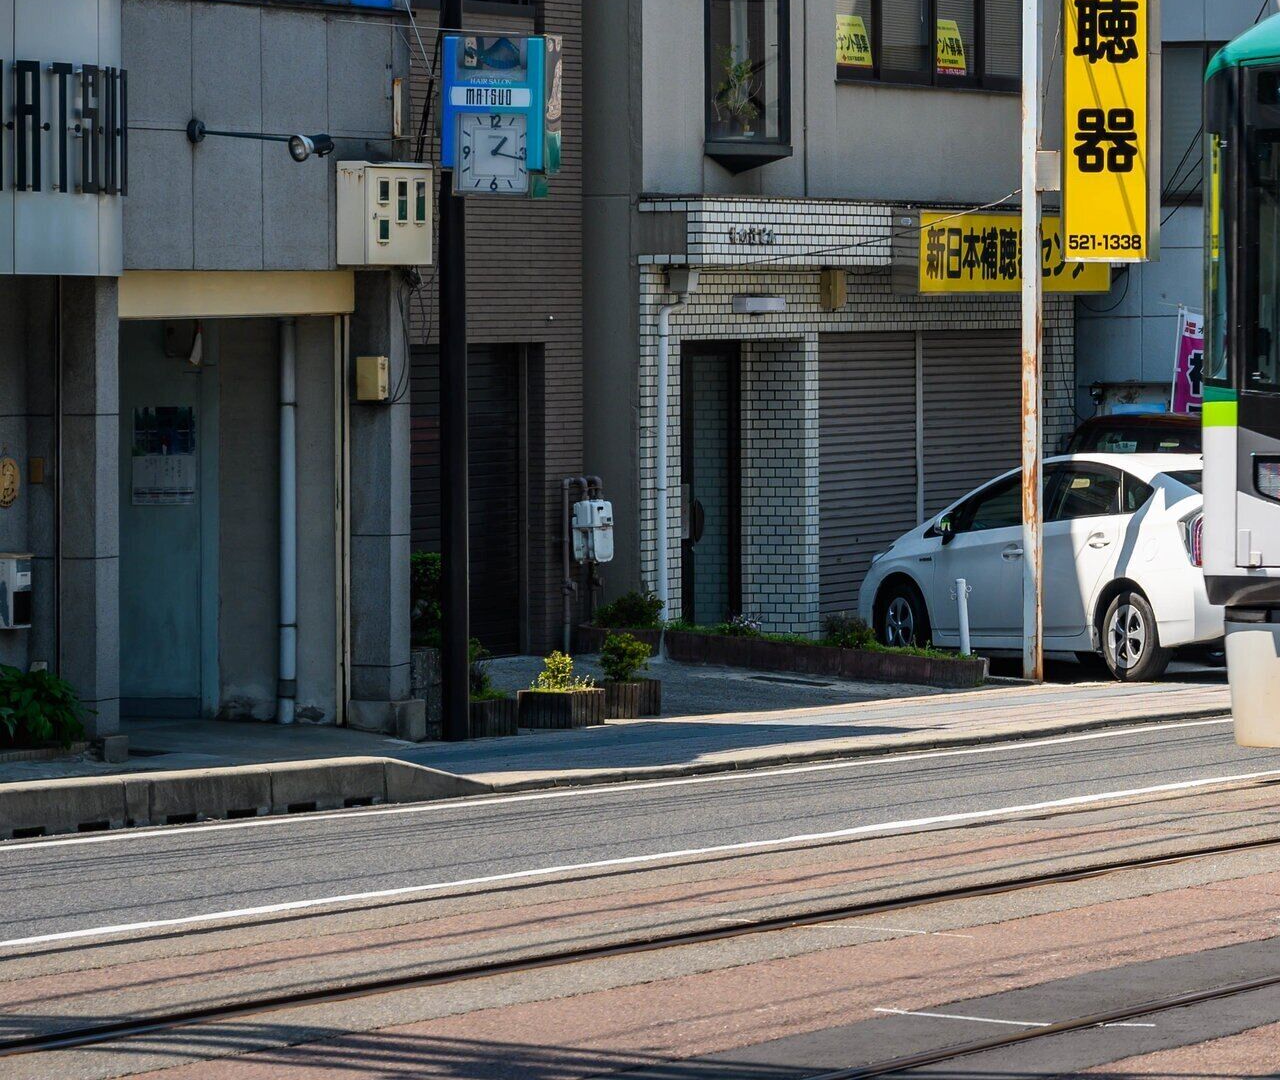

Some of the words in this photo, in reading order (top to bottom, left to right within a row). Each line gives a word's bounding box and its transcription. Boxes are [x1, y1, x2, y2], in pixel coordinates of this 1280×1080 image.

[466, 88, 512, 106] MATSUO
[0, 59, 129, 196] ATSUO
[489, 114, 502, 128] 12
[463, 145, 471, 160] 9
[490, 177, 498, 191] 6
[1068, 234, 1142, 250] 521-1338
[926, 225, 1085, 280] 新日本補聴セン
